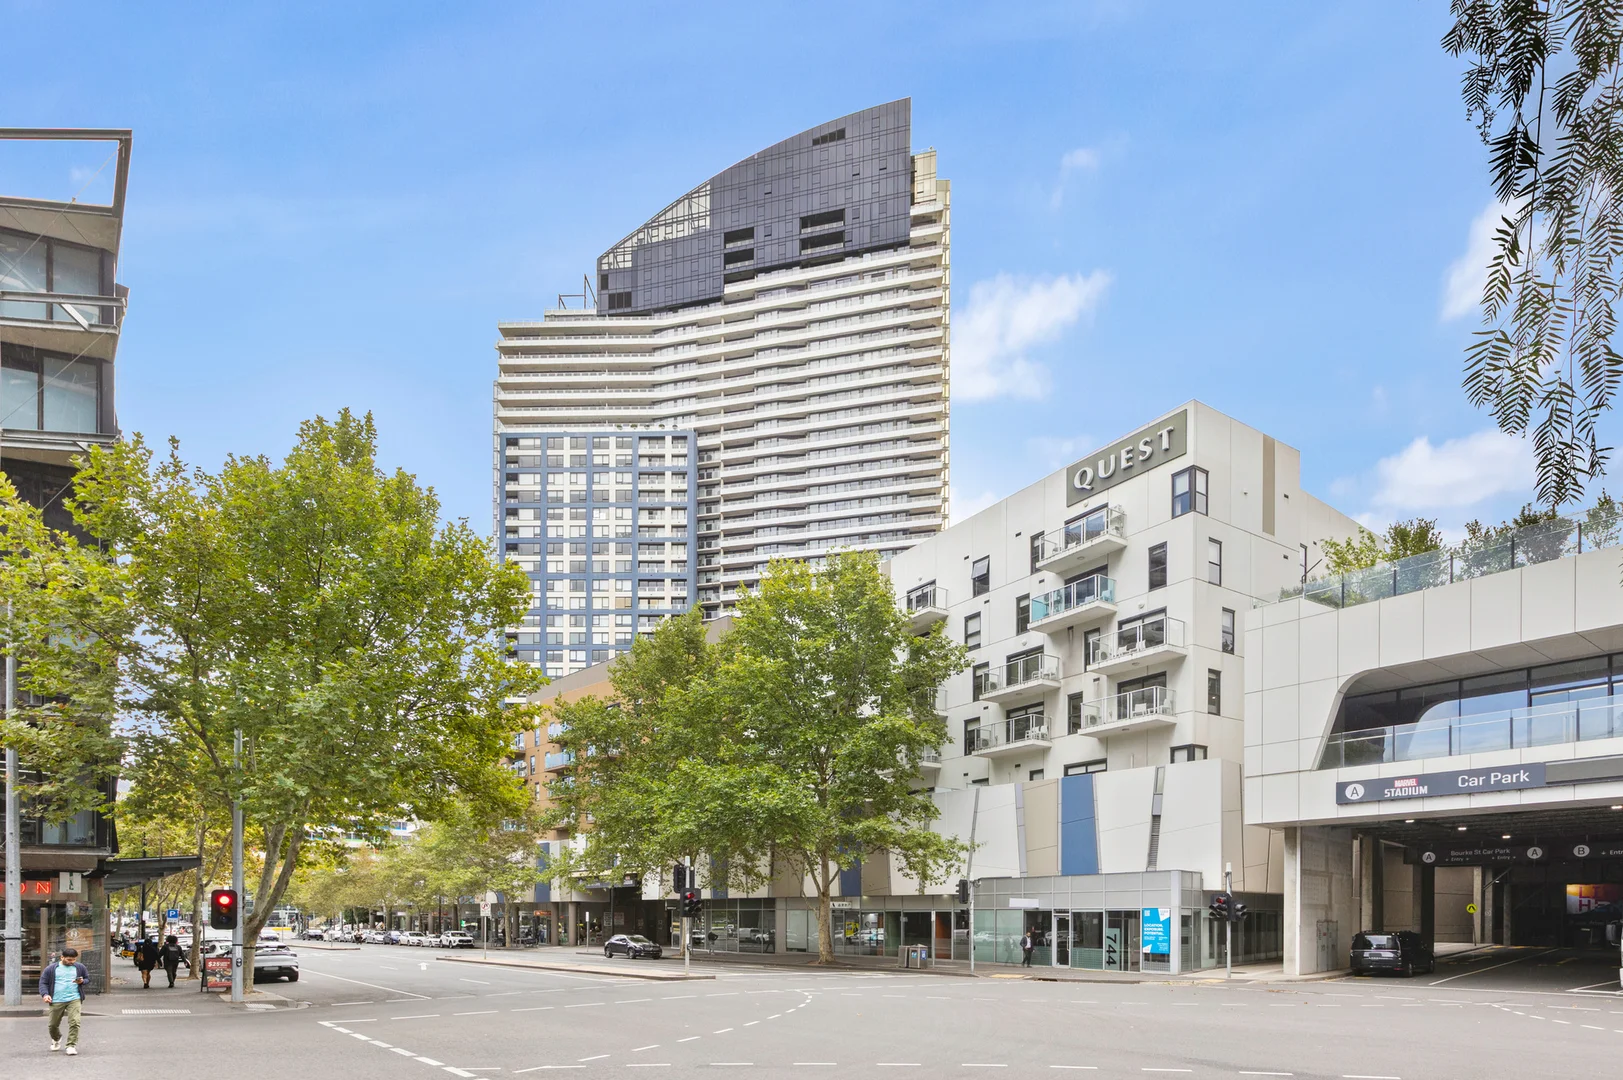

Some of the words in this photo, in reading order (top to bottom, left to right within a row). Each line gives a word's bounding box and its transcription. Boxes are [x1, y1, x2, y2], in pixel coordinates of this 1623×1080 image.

[1074, 426, 1174, 490] QUEST
[1394, 778, 1418, 787] MARVEL
[1457, 775, 1486, 788] Car
[1490, 769, 1530, 785] Park
[1350, 786, 1360, 797] A
[1384, 786, 1428, 798] STADIUM
[1577, 846, 1586, 855] B
[1106, 934, 1117, 966] 744
